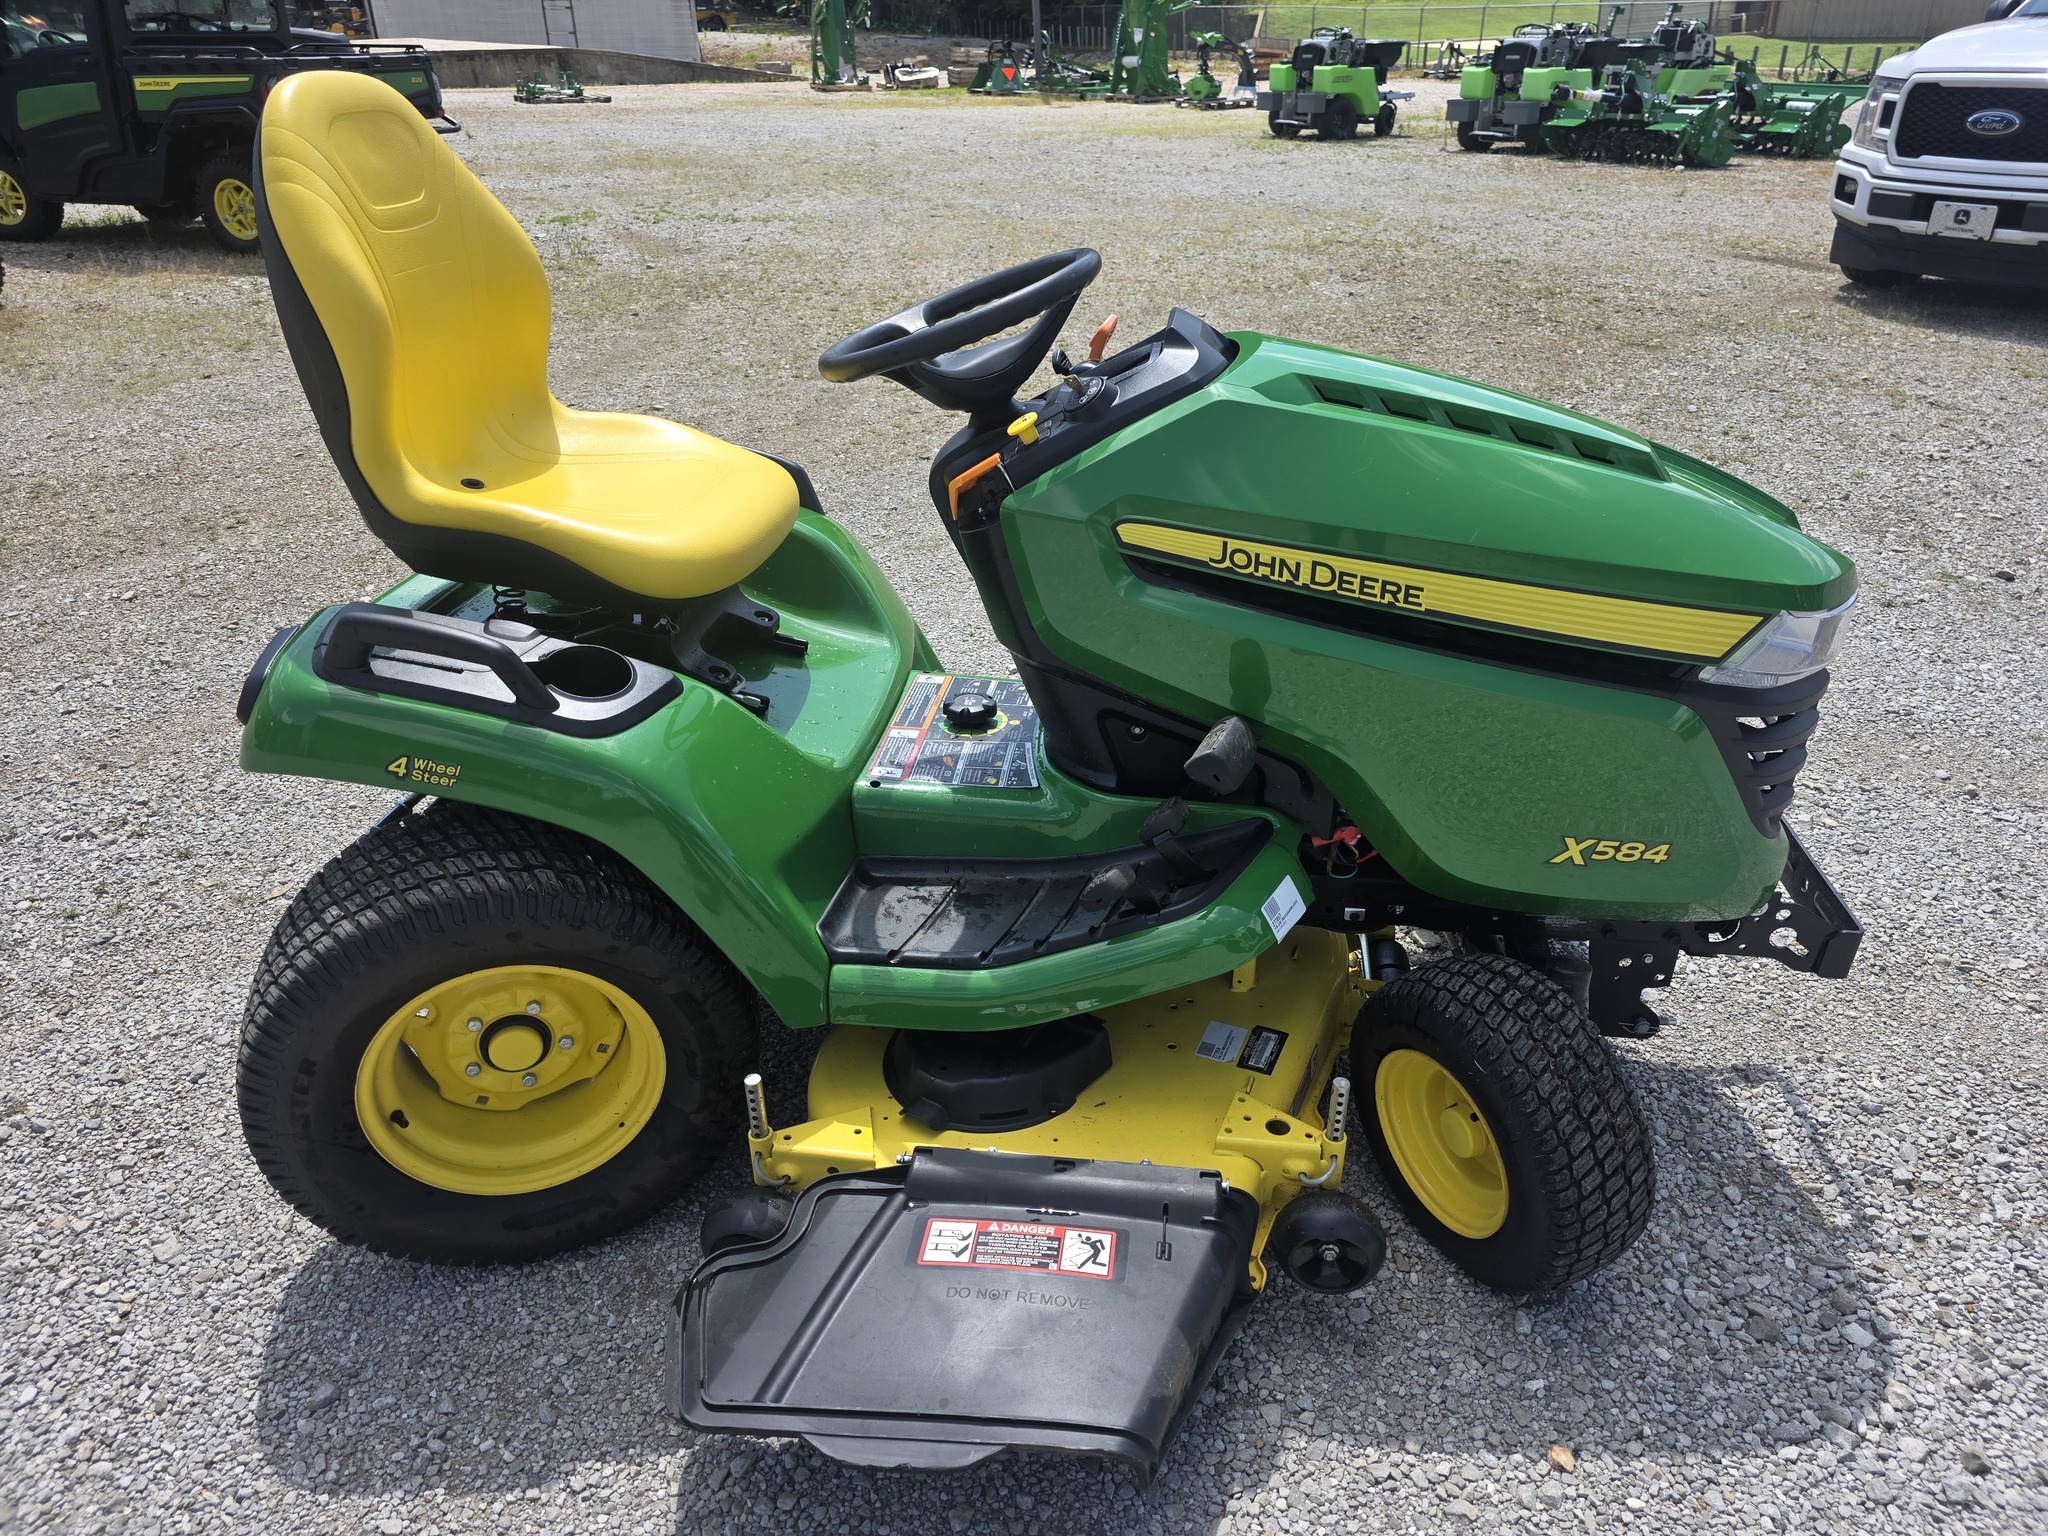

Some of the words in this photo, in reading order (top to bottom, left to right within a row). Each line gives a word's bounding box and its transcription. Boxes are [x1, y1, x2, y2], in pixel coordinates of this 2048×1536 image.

[138, 80, 153, 88] JOHN
[1976, 116, 2006, 130] Ford
[1208, 540, 1301, 582] JOHN
[1310, 560, 1425, 608] DEERE
[387, 756, 408, 777] 4
[414, 757, 461, 776] Wheel
[411, 769, 457, 787] Steer
[1548, 837, 1671, 866] X584
[1001, 1224, 1055, 1235] DANGER
[946, 1286, 971, 1299] DO
[976, 1288, 1012, 1300] NOT
[1016, 1291, 1091, 1310] REMOVE
